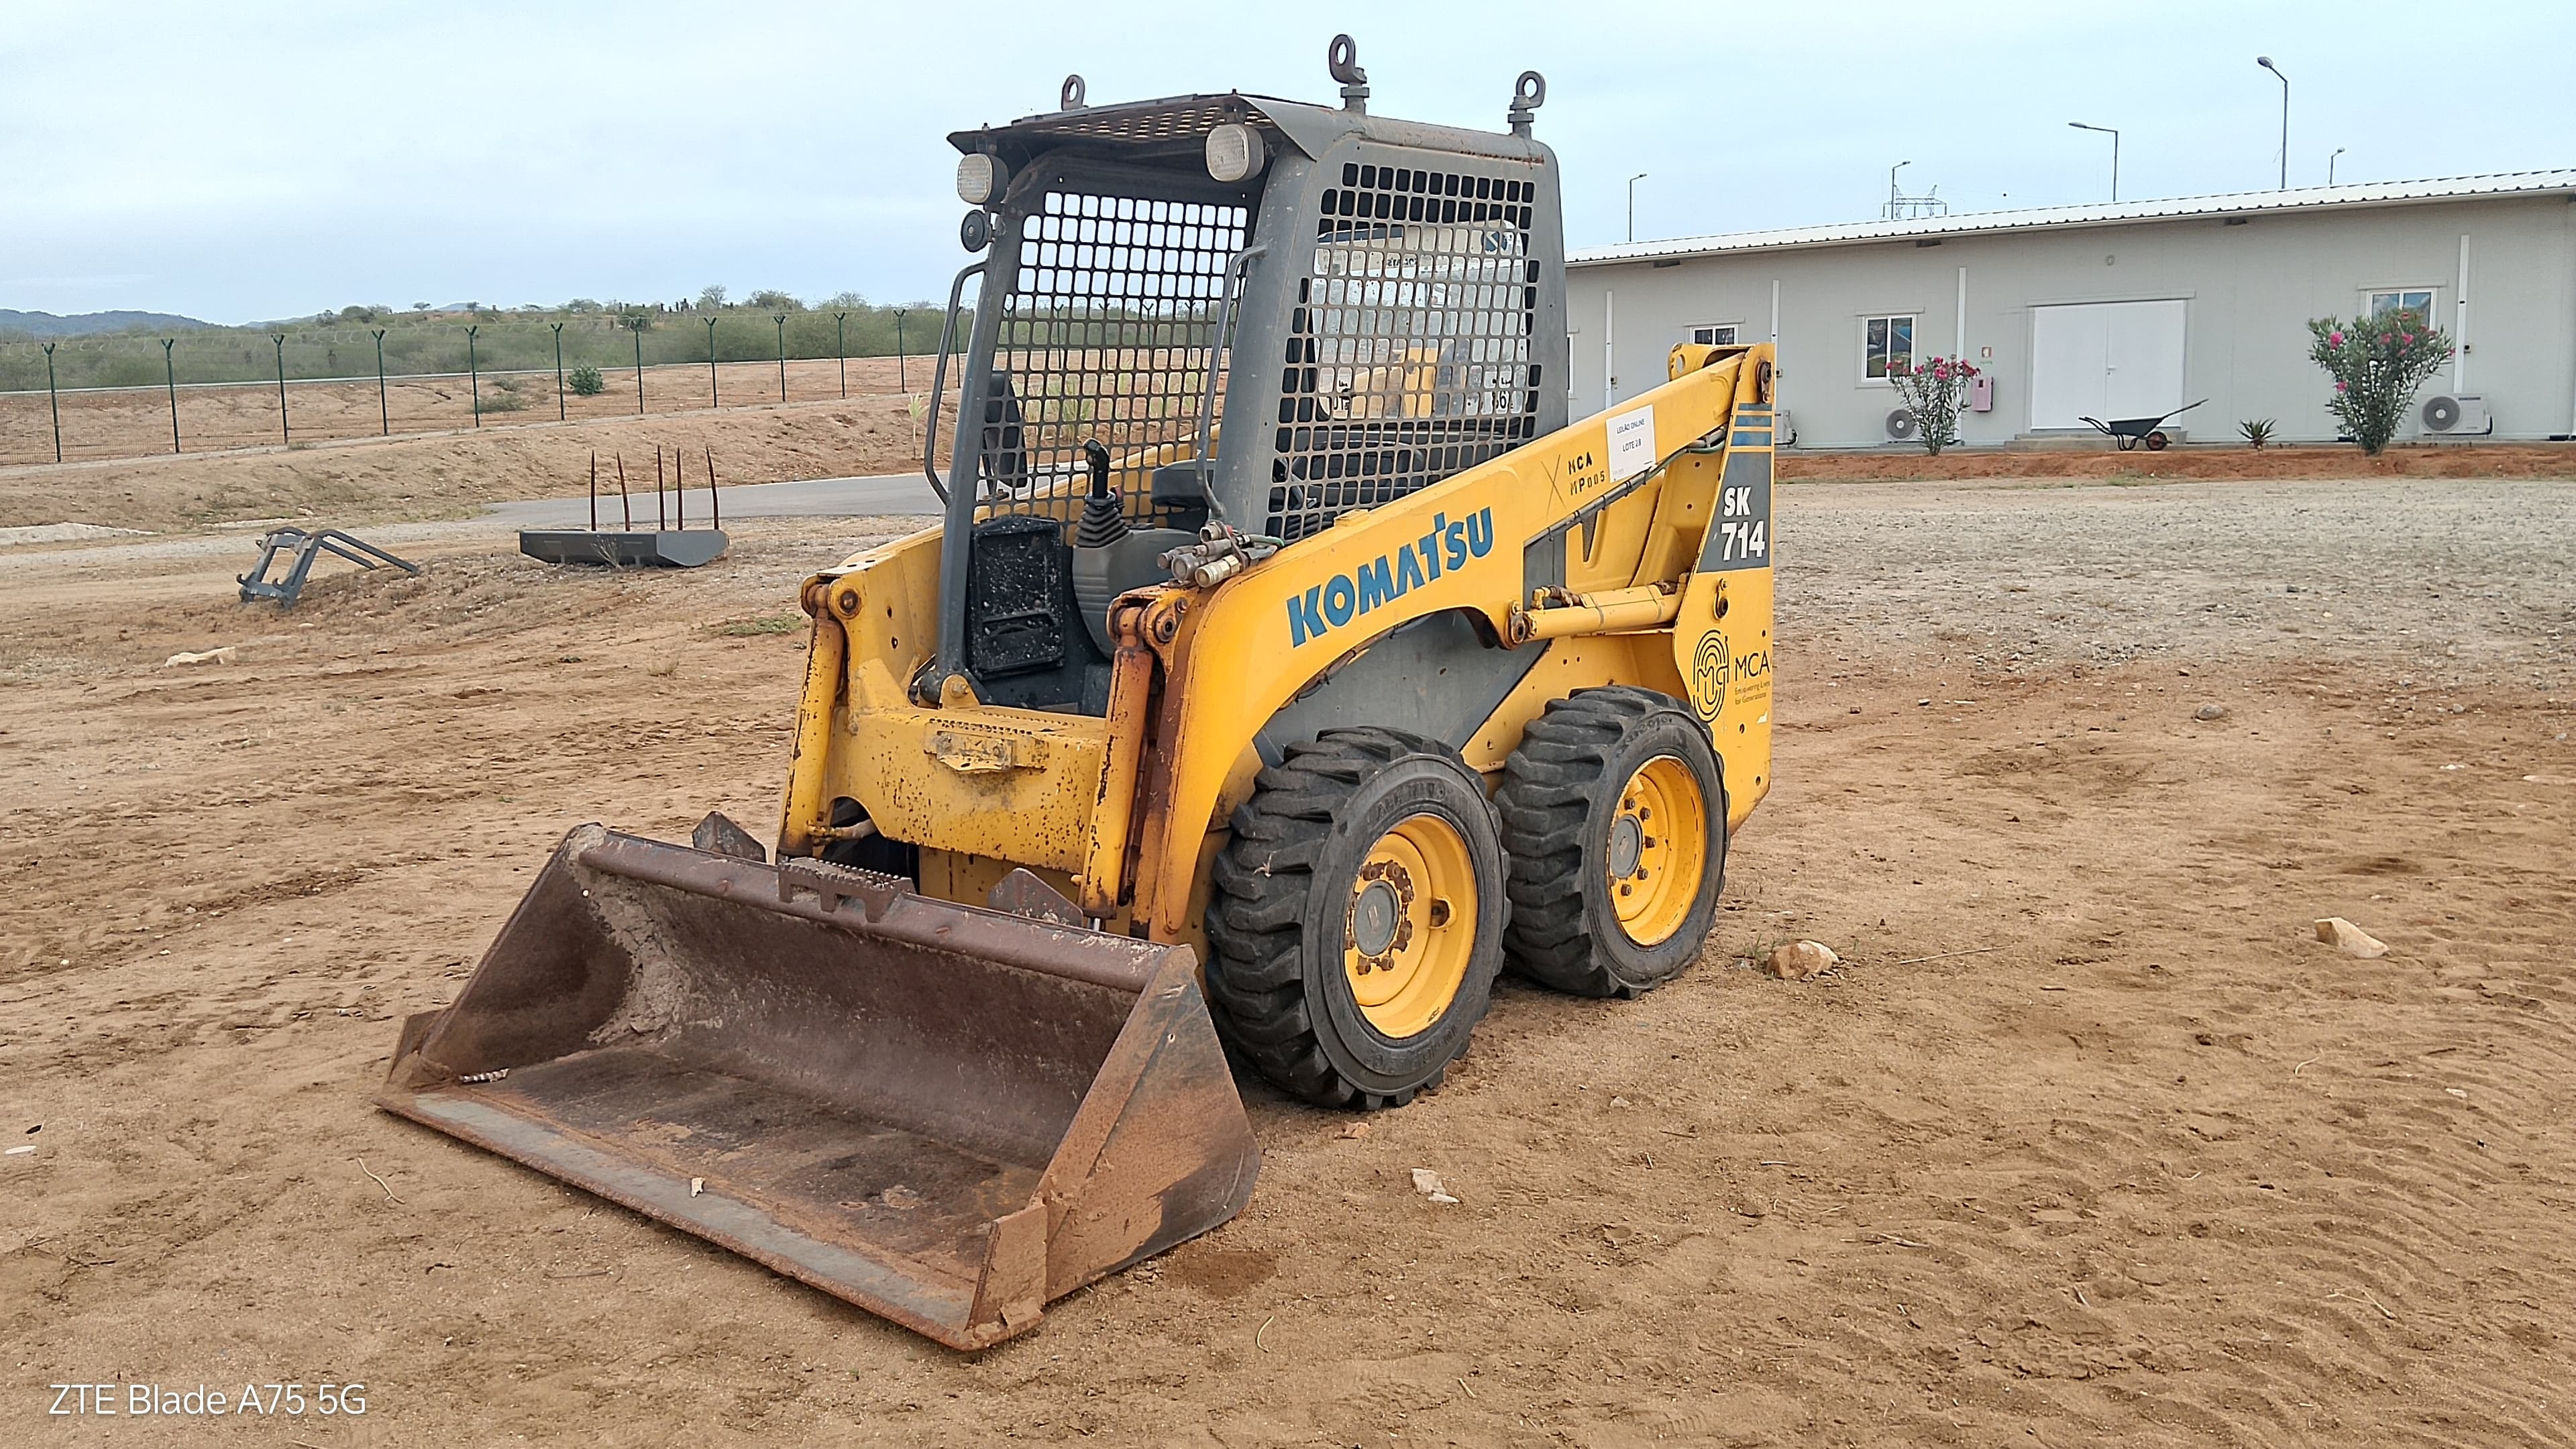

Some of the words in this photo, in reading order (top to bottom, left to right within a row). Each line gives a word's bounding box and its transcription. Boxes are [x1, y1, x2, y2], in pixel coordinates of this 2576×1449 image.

[1631, 418, 1644, 429] ONLINE
[1623, 441, 1634, 451] LOTE
[1568, 451, 1592, 475] MCA
[1570, 470, 1605, 496] MP005
[1723, 486, 1752, 517] SK
[1721, 520, 1766, 561] 714
[1286, 506, 1493, 649] KOMATSU
[1735, 650, 1770, 682] MCA
